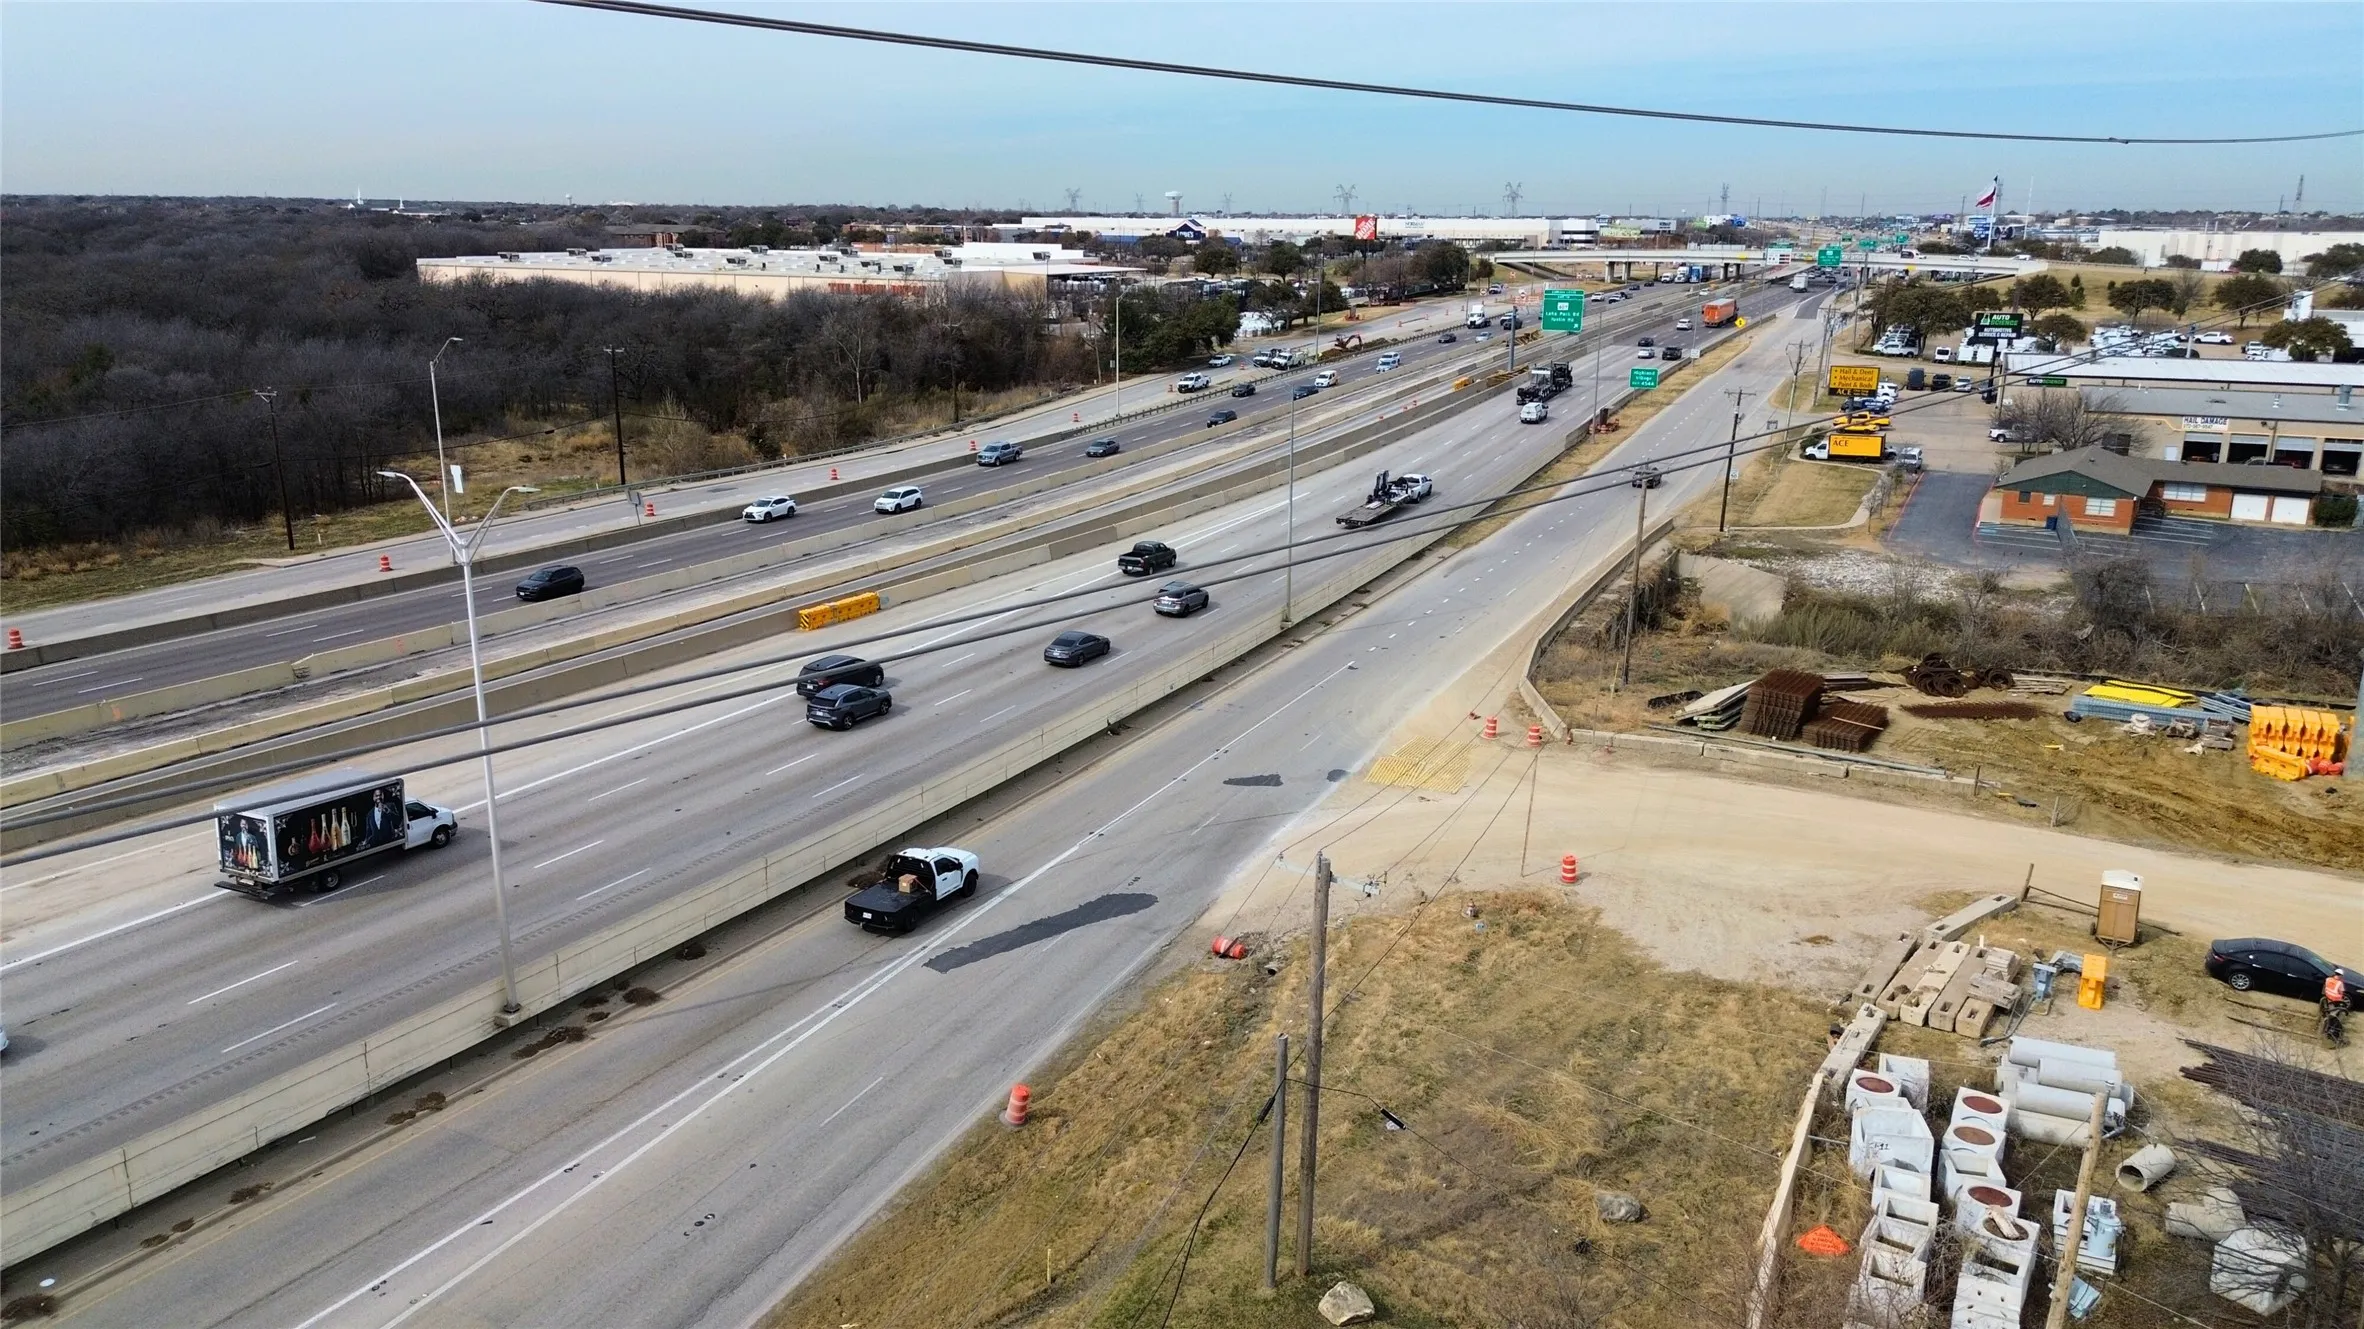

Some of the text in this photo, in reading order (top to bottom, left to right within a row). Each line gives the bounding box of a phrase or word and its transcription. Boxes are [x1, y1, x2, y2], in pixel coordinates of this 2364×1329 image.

[1836, 388, 1852, 396] ACE
[2184, 416, 2227, 426] HAIL DAMAGE
[1832, 439, 1849, 447] ACE
